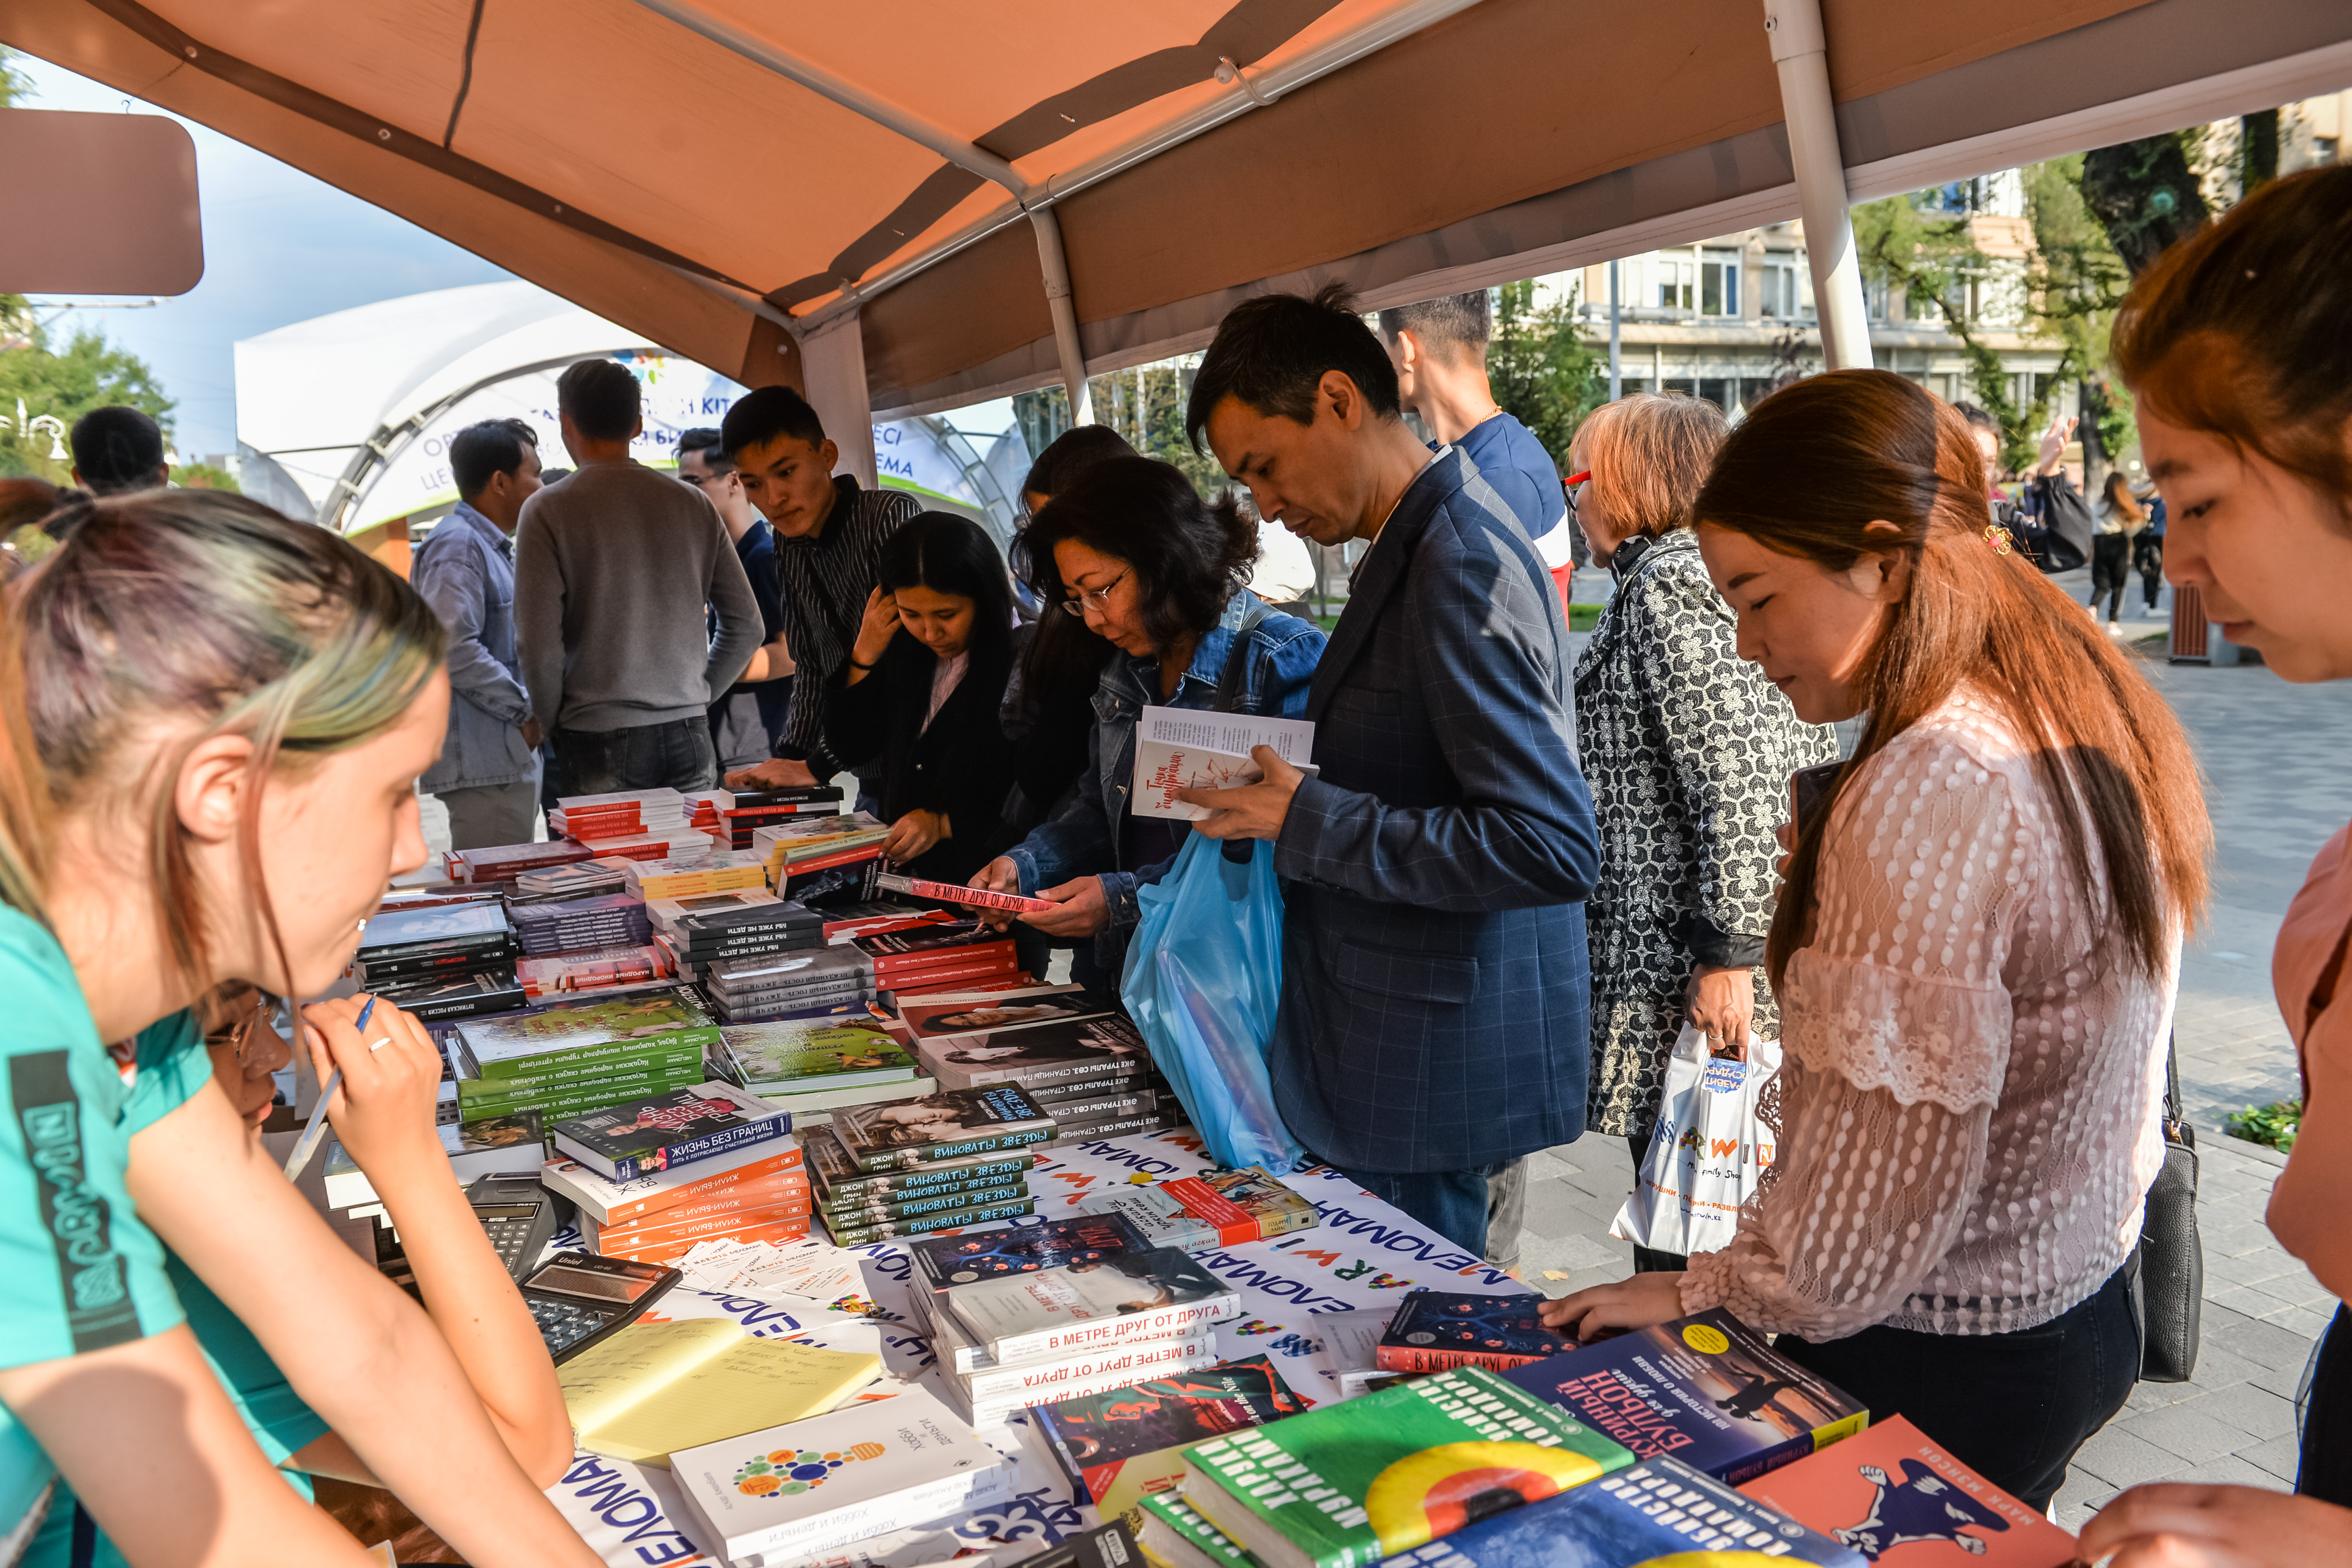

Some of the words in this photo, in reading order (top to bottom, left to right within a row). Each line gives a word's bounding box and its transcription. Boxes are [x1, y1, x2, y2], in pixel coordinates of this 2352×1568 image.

[934, 884, 940, 897] В
[942, 887, 968, 901] МЕТРЕ
[968, 891, 987, 904] ДРУГ
[575, 974, 613, 983] ИНОРОДНЫЕ
[750, 981, 777, 989] ДЖУЧИ
[806, 972, 848, 983] НЕЖДАННЫЙ
[809, 983, 850, 994] НЕЖДАННЫЙ
[755, 993, 781, 1002] ДЖУЧИ
[448, 1003, 474, 1012] ПУТИНСКАЯ
[580, 1064, 612, 1075] народные
[615, 1059, 649, 1070] Казахские
[1090, 1062, 1119, 1071] ТУРАЛЫ
[510, 1075, 546, 1086] животных
[556, 1069, 578, 1080] сказки
[614, 1073, 647, 1083] Казахские
[1034, 1068, 1071, 1079] СТРАНИЦЫ
[554, 1082, 577, 1092] сказки
[580, 1077, 612, 1087] народные
[1085, 1079, 1113, 1089] ТУРАЛЫ
[509, 1087, 545, 1098] животных
[584, 1092, 616, 1102] народные
[618, 1088, 652, 1097] Казахские
[514, 1102, 549, 1113] животных
[559, 1098, 581, 1107] сказки
[672, 1093, 729, 1122] ГРАНИЦ
[641, 1106, 695, 1133] ЖИЗНЬ
[668, 1104, 702, 1122] БЕЗ
[671, 1138, 709, 1158] ЖИЗНЬ
[711, 1132, 732, 1147] БЕЗ
[733, 1121, 773, 1142] ГРАНИЦ
[1060, 1128, 1096, 1139] СТРАНИЦЫ
[691, 1146, 723, 1159] ПОТРЯСАЮЩЕ
[725, 1136, 755, 1150] СЧАСТЛИВОЙ
[756, 1131, 773, 1139] ЖИЗНИ
[935, 1139, 996, 1158] ВИНОВАТЫ
[1002, 1130, 1047, 1147] ЗВЕЗДЫ
[870, 1154, 893, 1165] ДЖОН
[906, 1170, 969, 1187] ВИНОВАТЫ
[975, 1160, 1022, 1177] ЗВЕЗДЫ
[1724, 1170, 1741, 1181] Shop
[690, 1173, 739, 1194] ЖИЛИ-БЫЛИ
[840, 1183, 863, 1194] ДЖОН
[897, 1182, 960, 1200] ВИНОВАТЫ
[966, 1174, 1012, 1189] ЗВЕЗДЫ
[1646, 1179, 1676, 1196] ИГРУШКИ
[687, 1199, 740, 1216] ЖИЛИ-БЫЛИ
[688, 1217, 741, 1233] ЖИЛИ-БЫЛИ
[838, 1212, 861, 1222] ДЖОН
[1268, 1219, 1289, 1227] ГОДФРИ
[1049, 1337, 1059, 1349] В
[1064, 1326, 1111, 1347] МЕТРЕ
[1115, 1318, 1151, 1338] ДРУГ
[1155, 1313, 1172, 1328] ОТ
[1176, 1304, 1221, 1326] ДРУГА
[1136, 1346, 1182, 1366] МЕТРЕ
[1186, 1345, 1195, 1356] В
[1073, 1364, 1091, 1377] ОТ
[1096, 1354, 1132, 1373] ДРУГ
[1632, 1355, 1668, 1384] ЛЮБВИ
[1023, 1367, 1069, 1386] ДРУГА
[1222, 1377, 1240, 1392] Nile
[1611, 1369, 1656, 1398] души
[1234, 1393, 1248, 1404] the
[1670, 1387, 1716, 1420] ИСТОРИЯ
[1243, 1405, 1256, 1414] on
[1407, 1379, 1513, 1442] УБИЙСТВО
[1432, 1371, 1563, 1447] КОМАНДОРА
[1580, 1369, 1694, 1451] БУЛЬОН
[1647, 1399, 1681, 1417] для
[1556, 1378, 1664, 1459] КУРИНЫЙ
[898, 1428, 926, 1451] Хобби
[1194, 1439, 1299, 1510] ХАРУКИ
[1918, 1446, 1984, 1492] МЭНСОН
[1229, 1430, 1369, 1529] МУРАКАМИ
[832, 1507, 868, 1525] Хобби
[1600, 1477, 1734, 1552] УБИЙСТВО
[1625, 1467, 1792, 1557] КОМАНДОРА
[1987, 1494, 2036, 1525] МАРК
[769, 1521, 815, 1542] деньги
